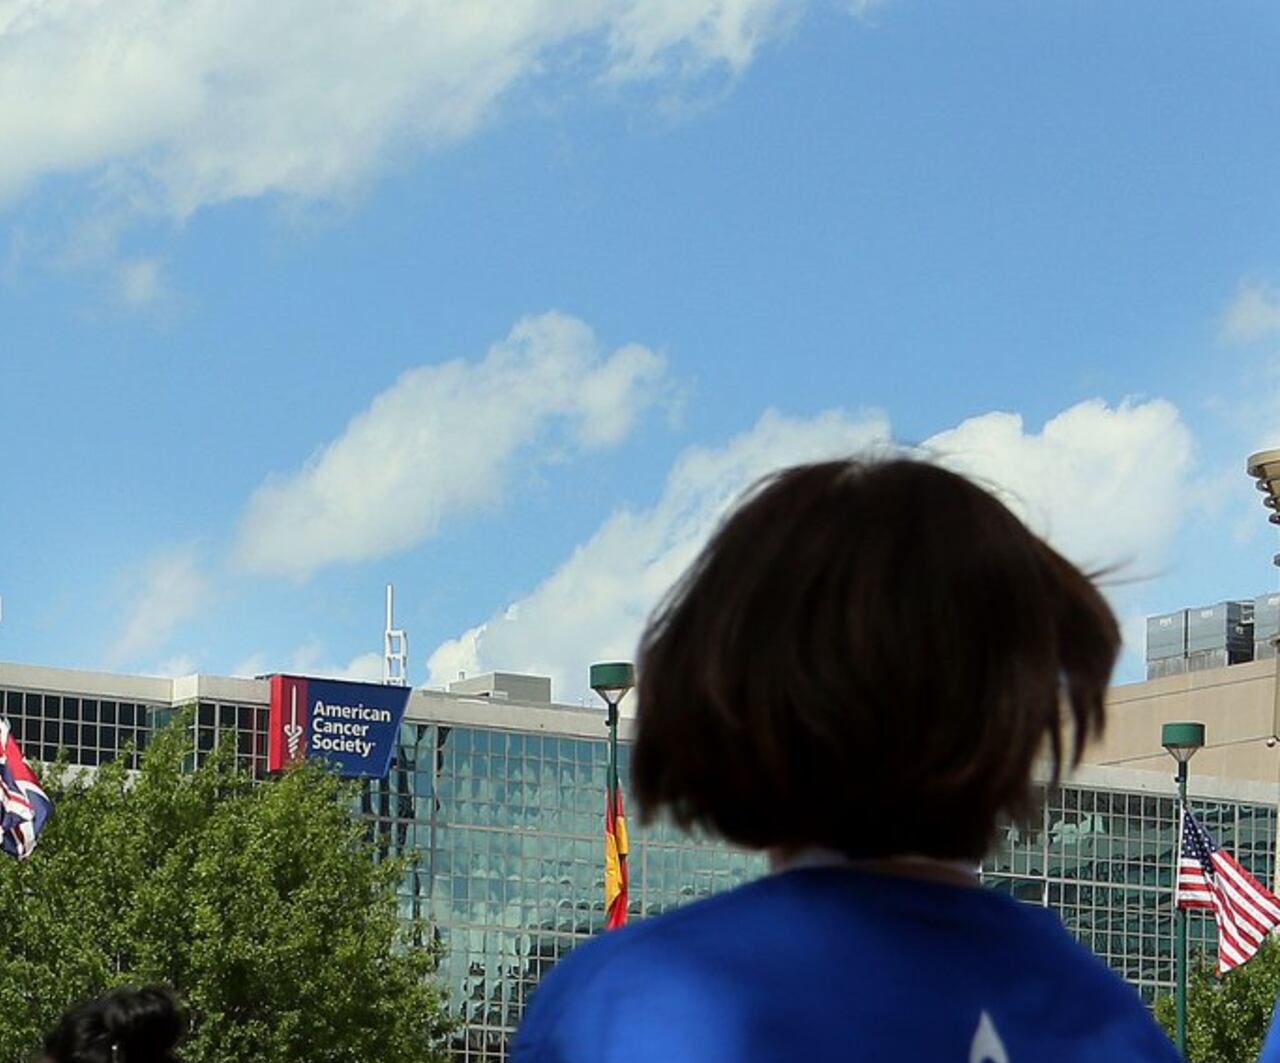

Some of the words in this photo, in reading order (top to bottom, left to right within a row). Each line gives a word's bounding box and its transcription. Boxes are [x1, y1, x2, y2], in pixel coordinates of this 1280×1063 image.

[313, 701, 391, 722] American
[312, 717, 370, 736] Cancer
[312, 733, 372, 758] Society
